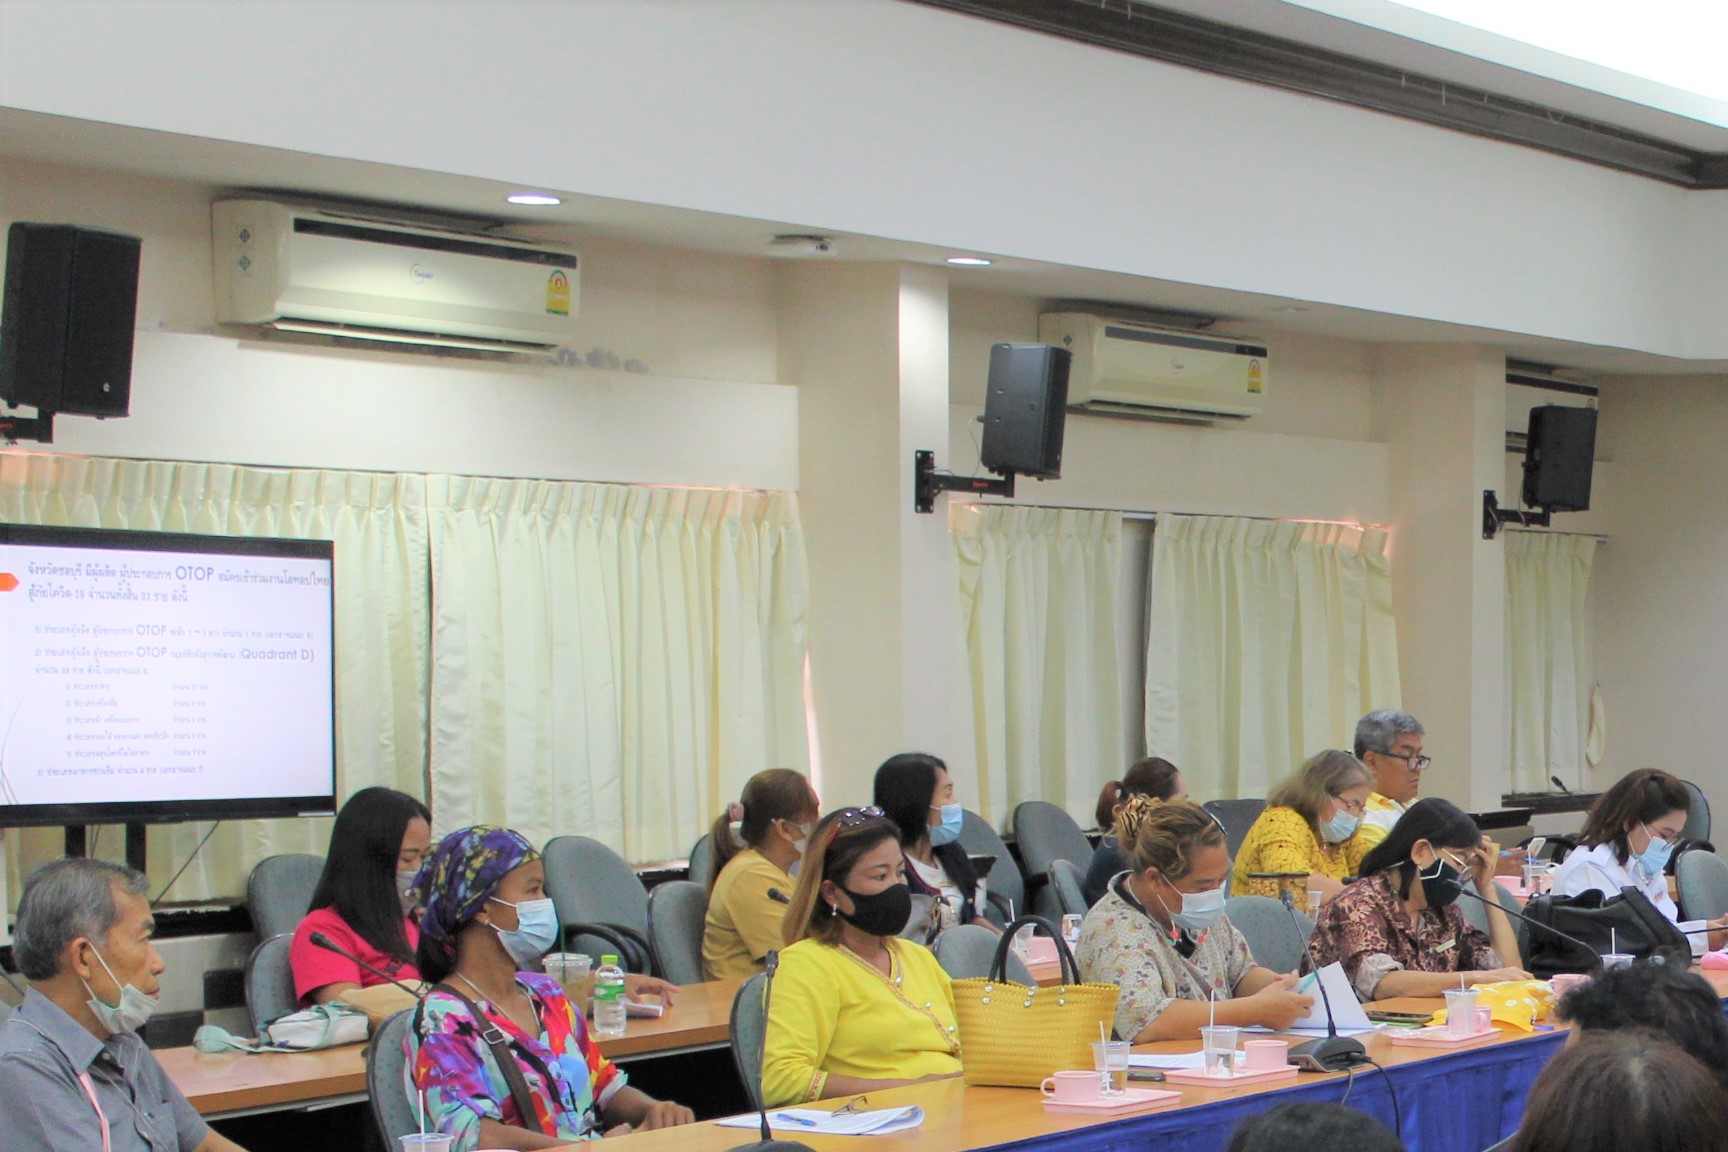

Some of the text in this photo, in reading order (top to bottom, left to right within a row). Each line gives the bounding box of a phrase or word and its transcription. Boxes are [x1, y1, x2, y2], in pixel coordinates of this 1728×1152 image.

[175, 565, 214, 581] OTOP
[135, 624, 167, 636] OTOP
[136, 646, 167, 658] OTOP
[301, 649, 314, 663] D)
